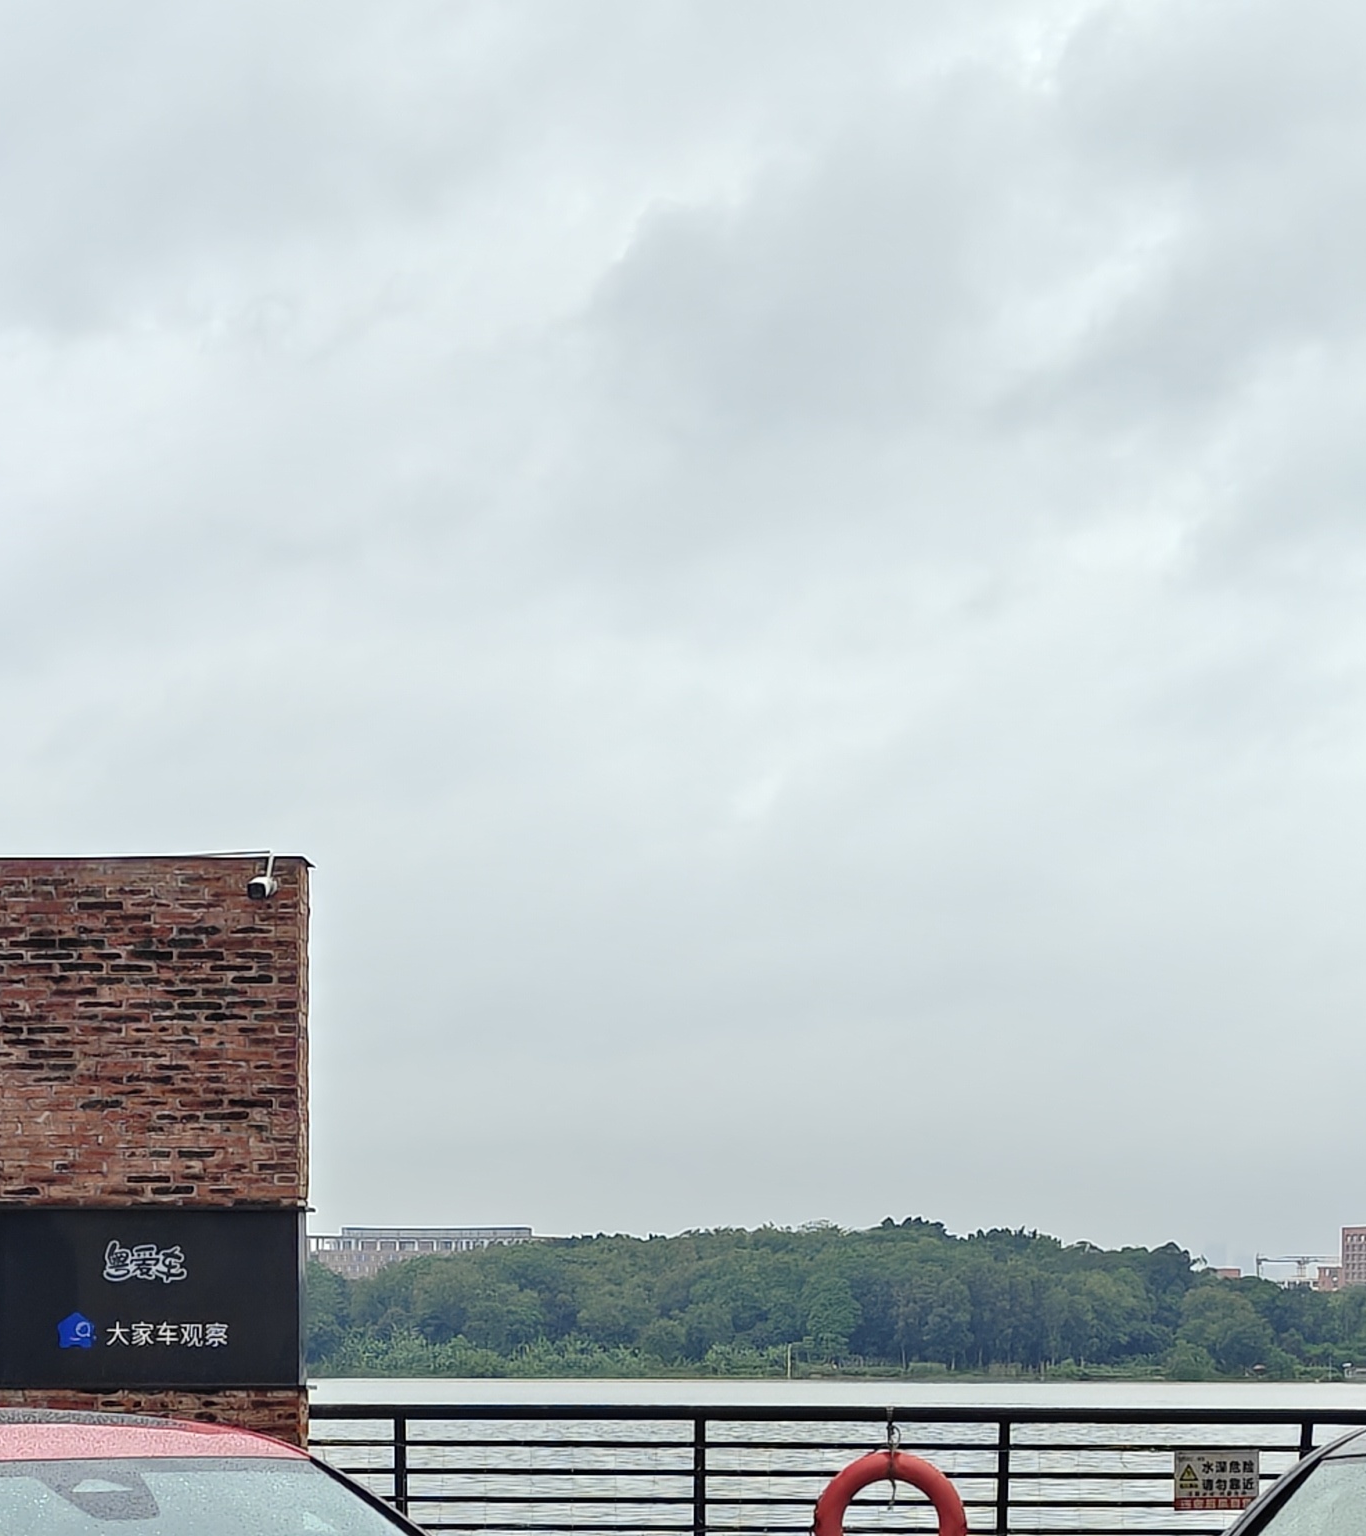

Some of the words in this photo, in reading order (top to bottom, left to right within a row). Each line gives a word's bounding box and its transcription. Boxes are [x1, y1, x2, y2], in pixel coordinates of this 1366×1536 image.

[106, 1321, 229, 1347] 大家车观察
[1201, 1460, 1254, 1474] 水深危险
[1201, 1477, 1254, 1491] 请勿靠近
